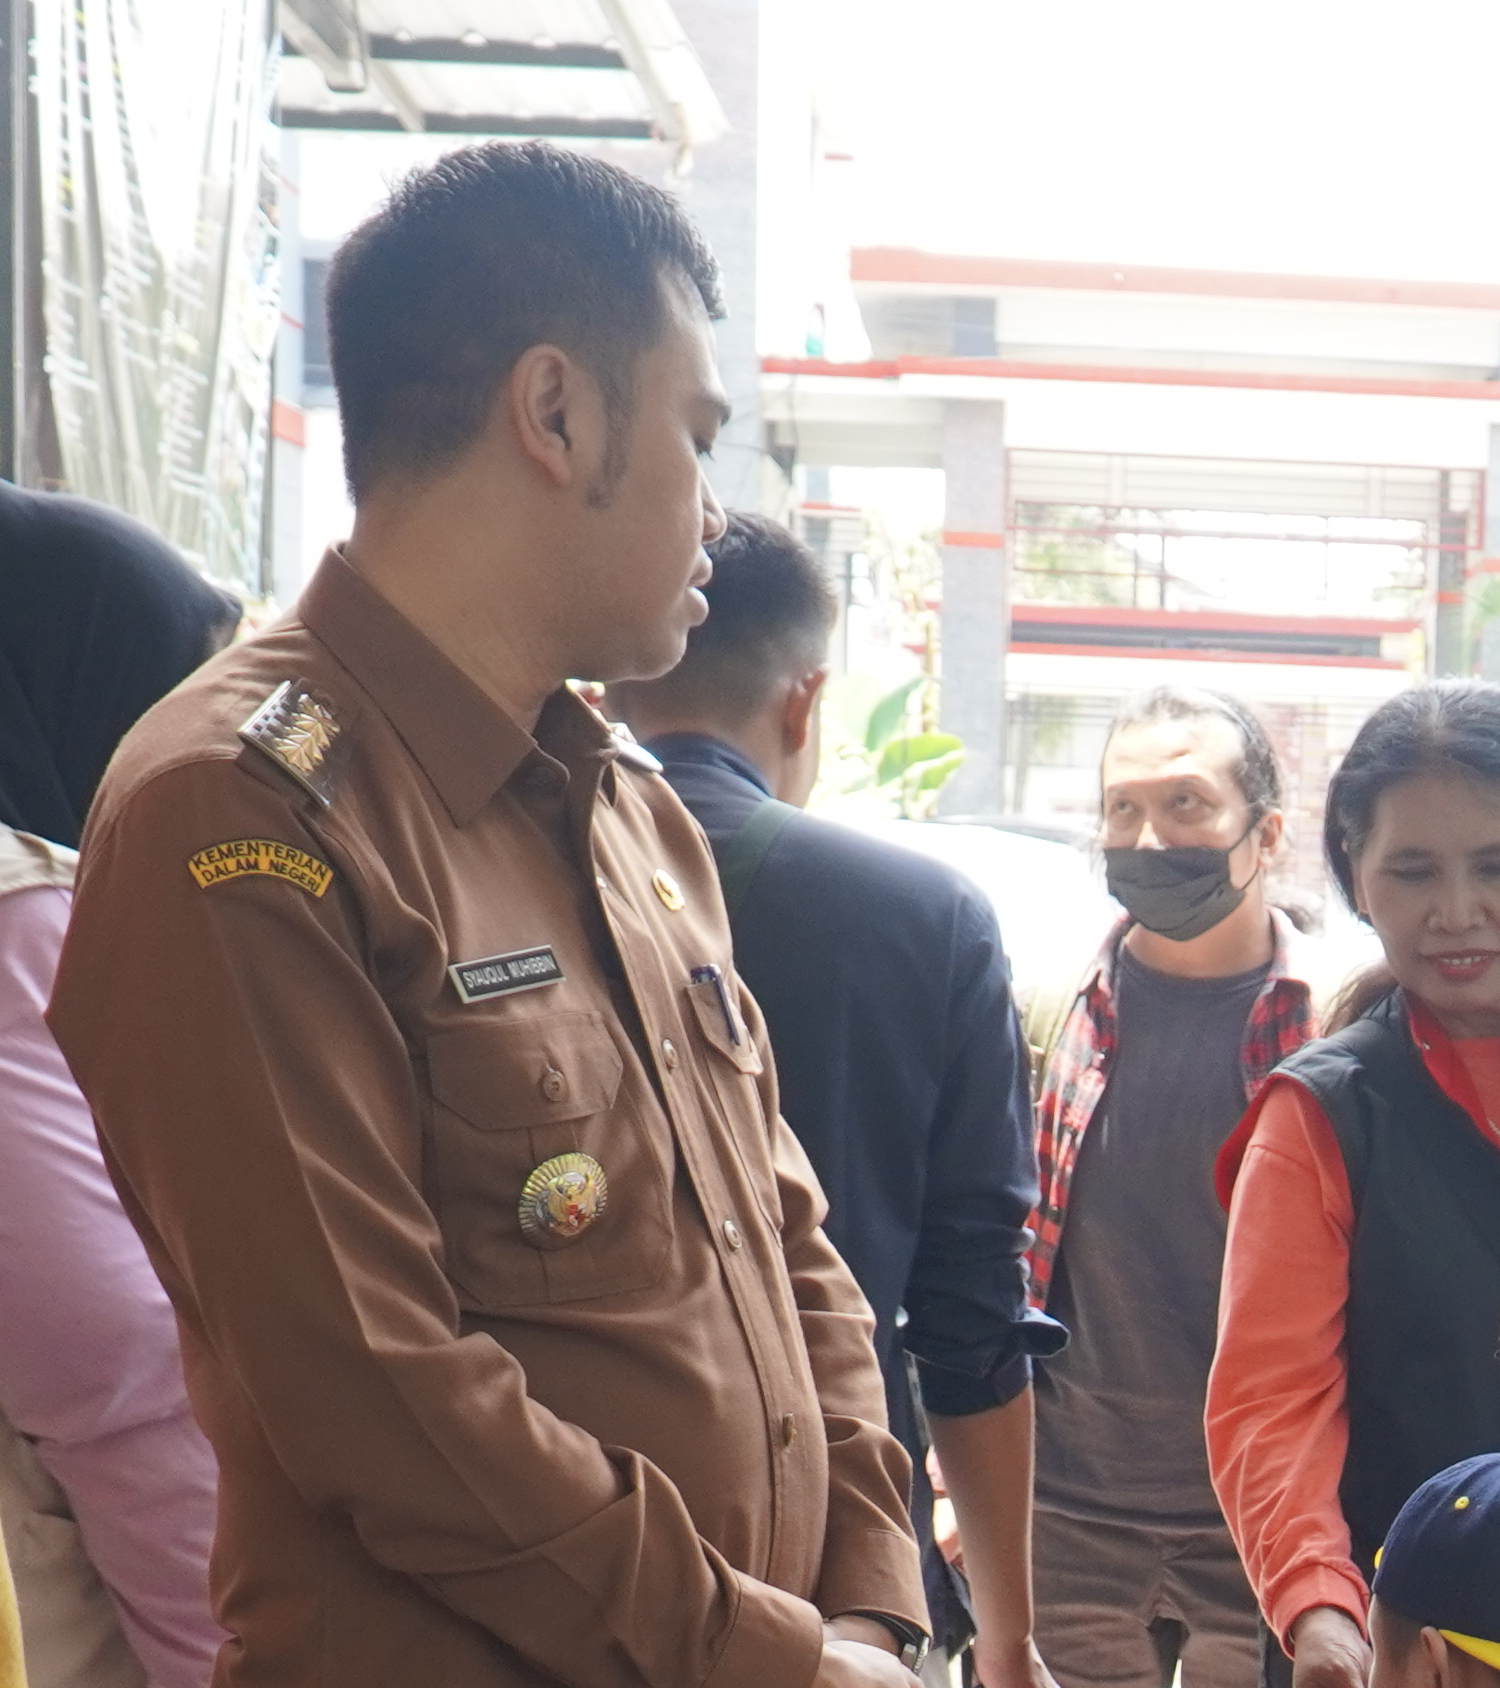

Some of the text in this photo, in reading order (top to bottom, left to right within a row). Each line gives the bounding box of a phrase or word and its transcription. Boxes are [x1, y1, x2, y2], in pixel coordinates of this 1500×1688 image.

[191, 840, 328, 881] KEMENTERIAN
[201, 857, 320, 891] DALAM NEGERI
